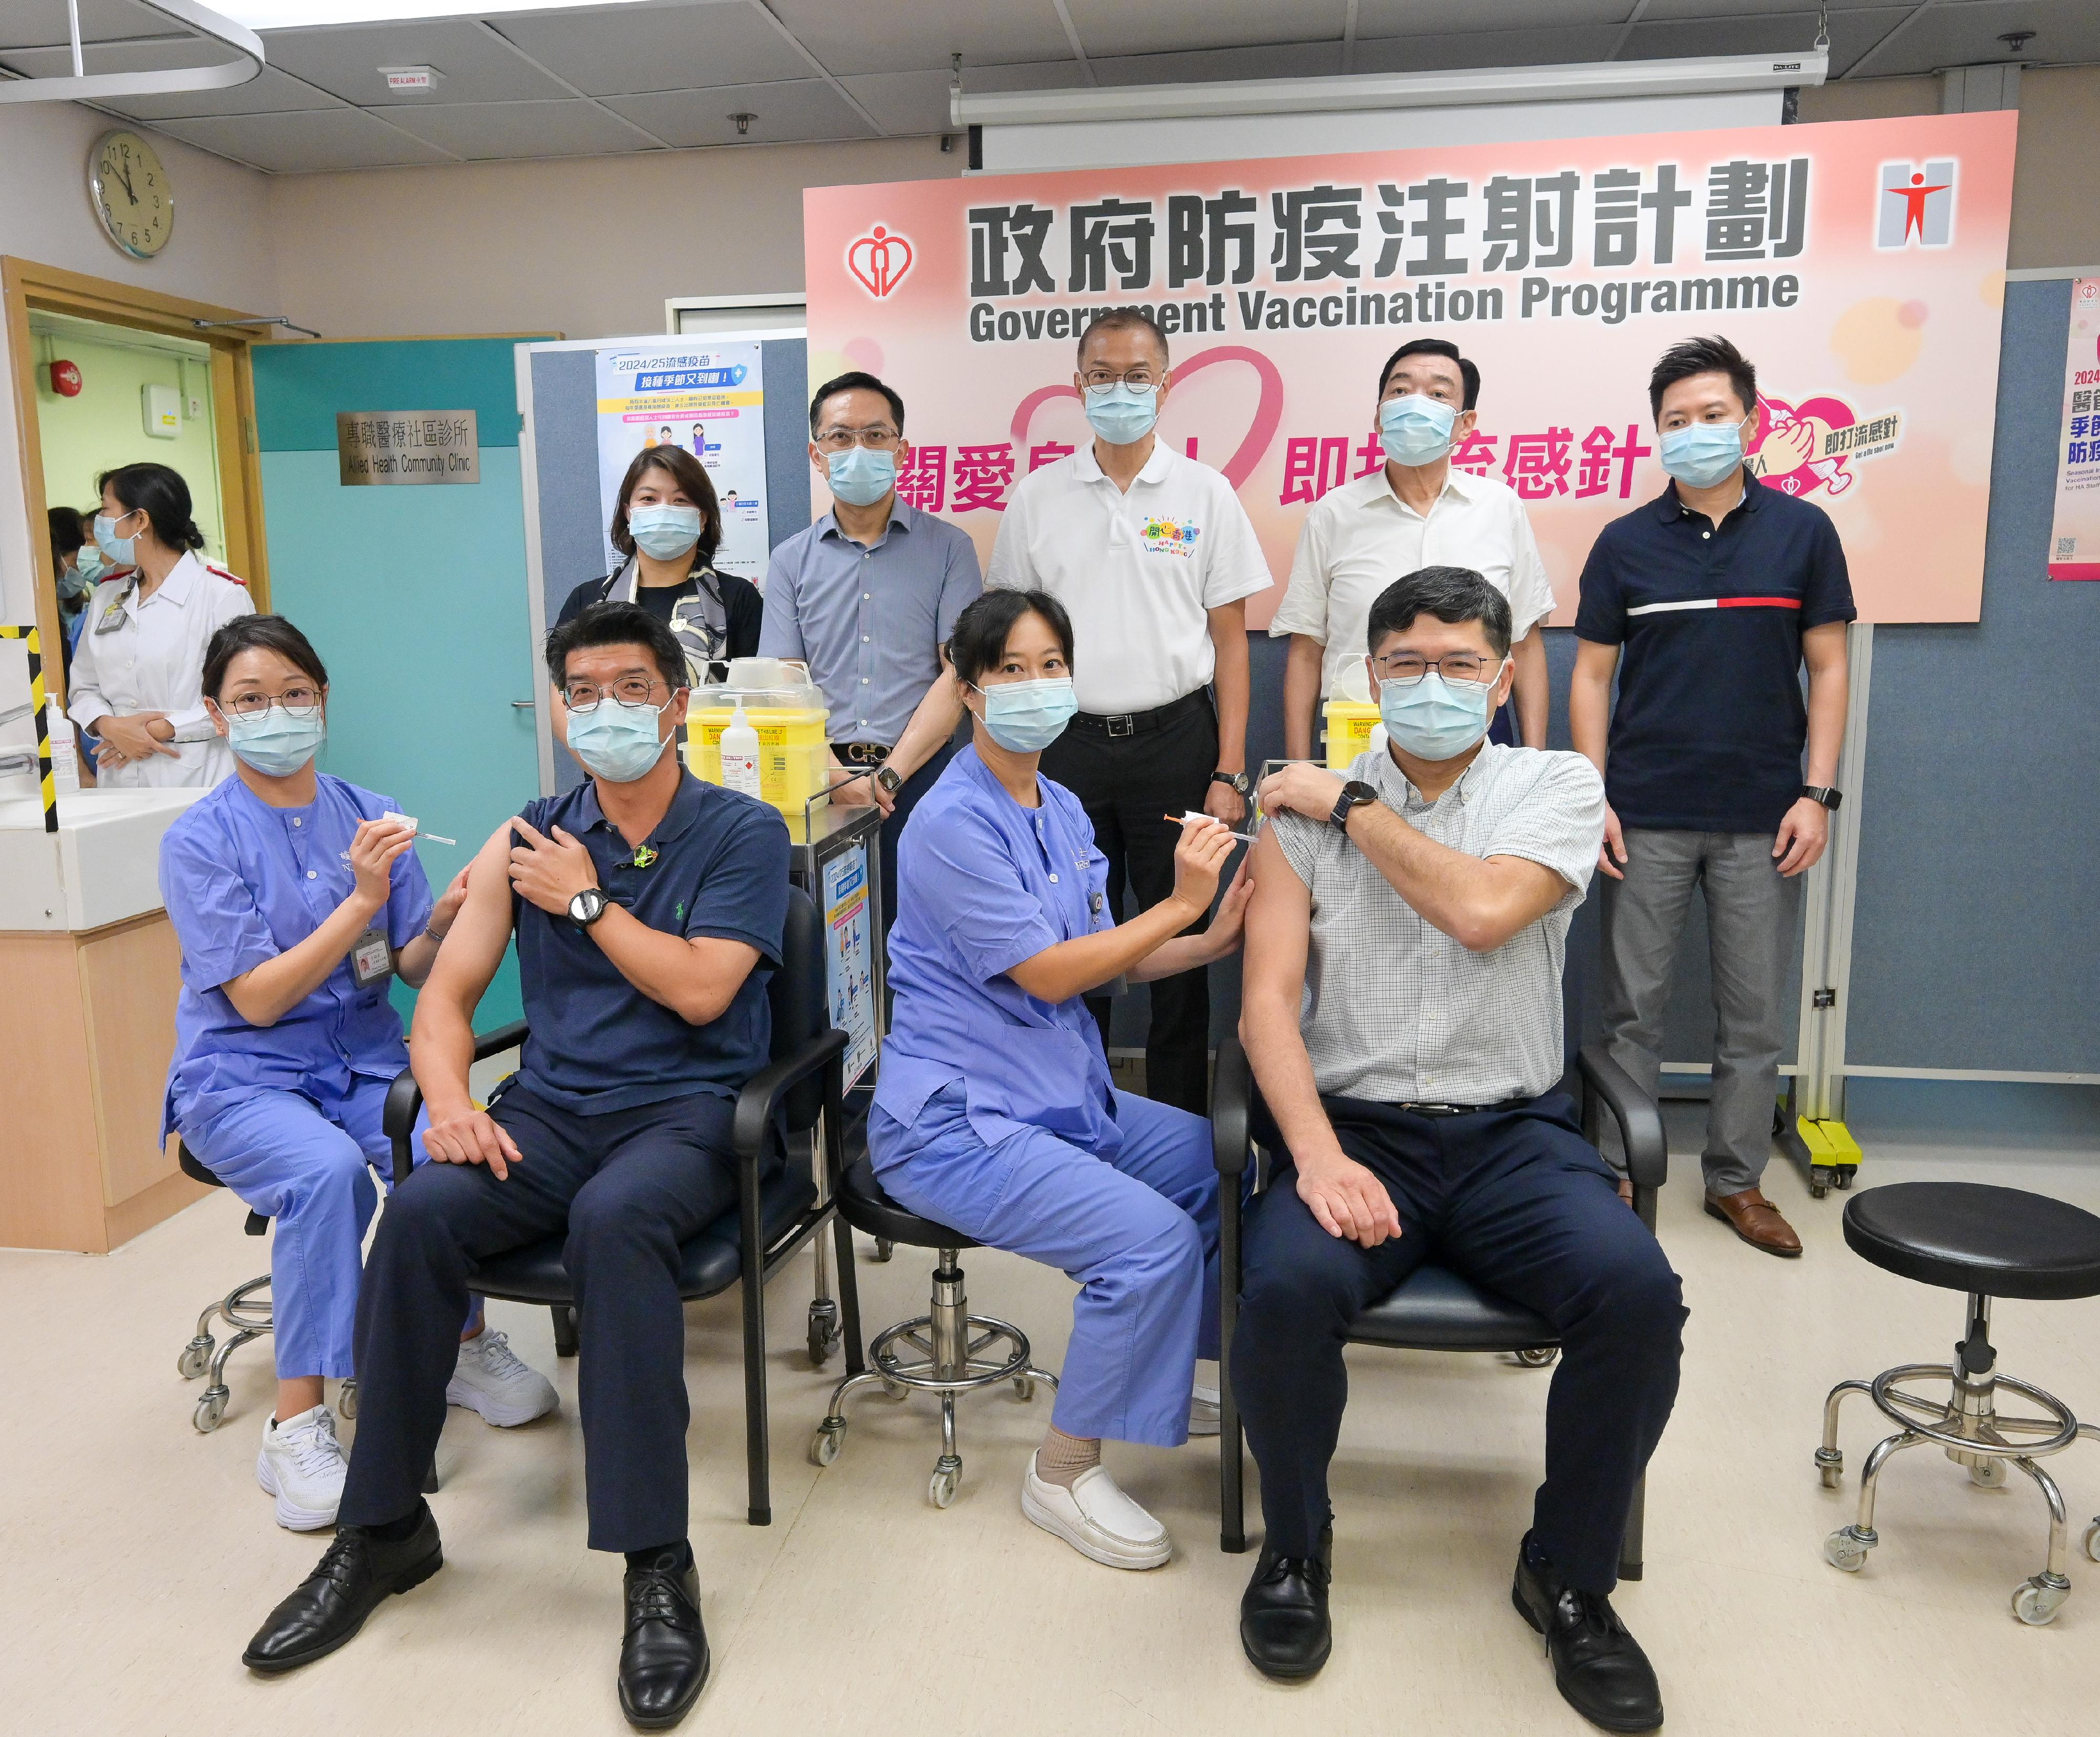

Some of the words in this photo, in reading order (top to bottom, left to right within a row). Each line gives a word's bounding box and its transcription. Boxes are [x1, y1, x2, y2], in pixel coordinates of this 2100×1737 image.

[107, 145, 117, 160] 11
[120, 142, 130, 158] 12
[100, 160, 109, 175] 10
[136, 154, 142, 168] 1
[147, 172, 154, 186] 2
[153, 195, 159, 208] 3
[105, 203, 111, 217] 8
[117, 222, 122, 235] 7
[153, 217, 158, 230] 4
[969, 158, 1809, 298] 政府防疫注射計劃
[132, 232, 138, 245] 6
[144, 228, 151, 243] 5
[1238, 282, 1503, 331] Vaccination
[1521, 274, 1799, 325] Programme
[619, 355, 710, 371] 2024/25流感疫苗
[1825, 415, 1898, 456] 即打流感針
[348, 455, 369, 473] Allied
[372, 454, 397, 473] Health
[401, 453, 445, 476] Community
[448, 452, 470, 472] Clinic
[1149, 525, 1193, 541] 開心香港
[1159, 540, 1182, 549] HAPPY
